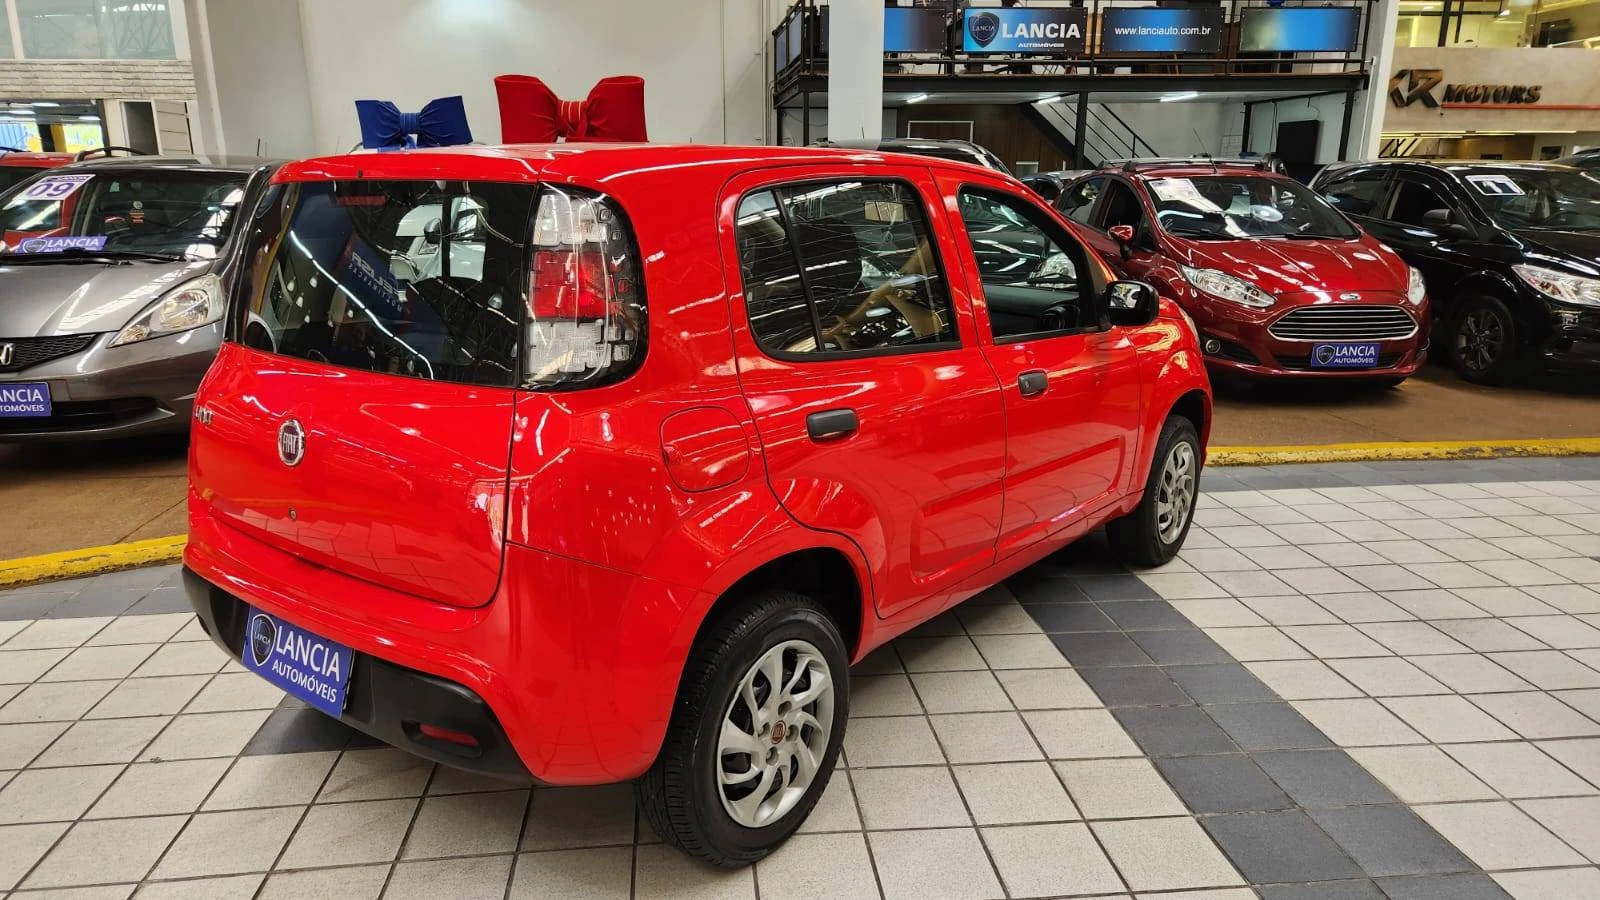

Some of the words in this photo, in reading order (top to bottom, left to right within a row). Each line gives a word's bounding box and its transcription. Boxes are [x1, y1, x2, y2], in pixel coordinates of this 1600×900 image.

[1002, 23, 1080, 38] LANCIA
[1114, 25, 1211, 36] www.lanciauto.com.br
[1443, 84, 1541, 104] MOTORS
[27, 182, 76, 197] 09
[47, 238, 99, 248] LANCIA
[1335, 346, 1375, 357] LANCIA
[282, 432, 298, 454] FIAT
[254, 631, 271, 645] LANCIA
[276, 625, 340, 683] LANCIA
[272, 659, 338, 703] AUTOMÓVEIS
